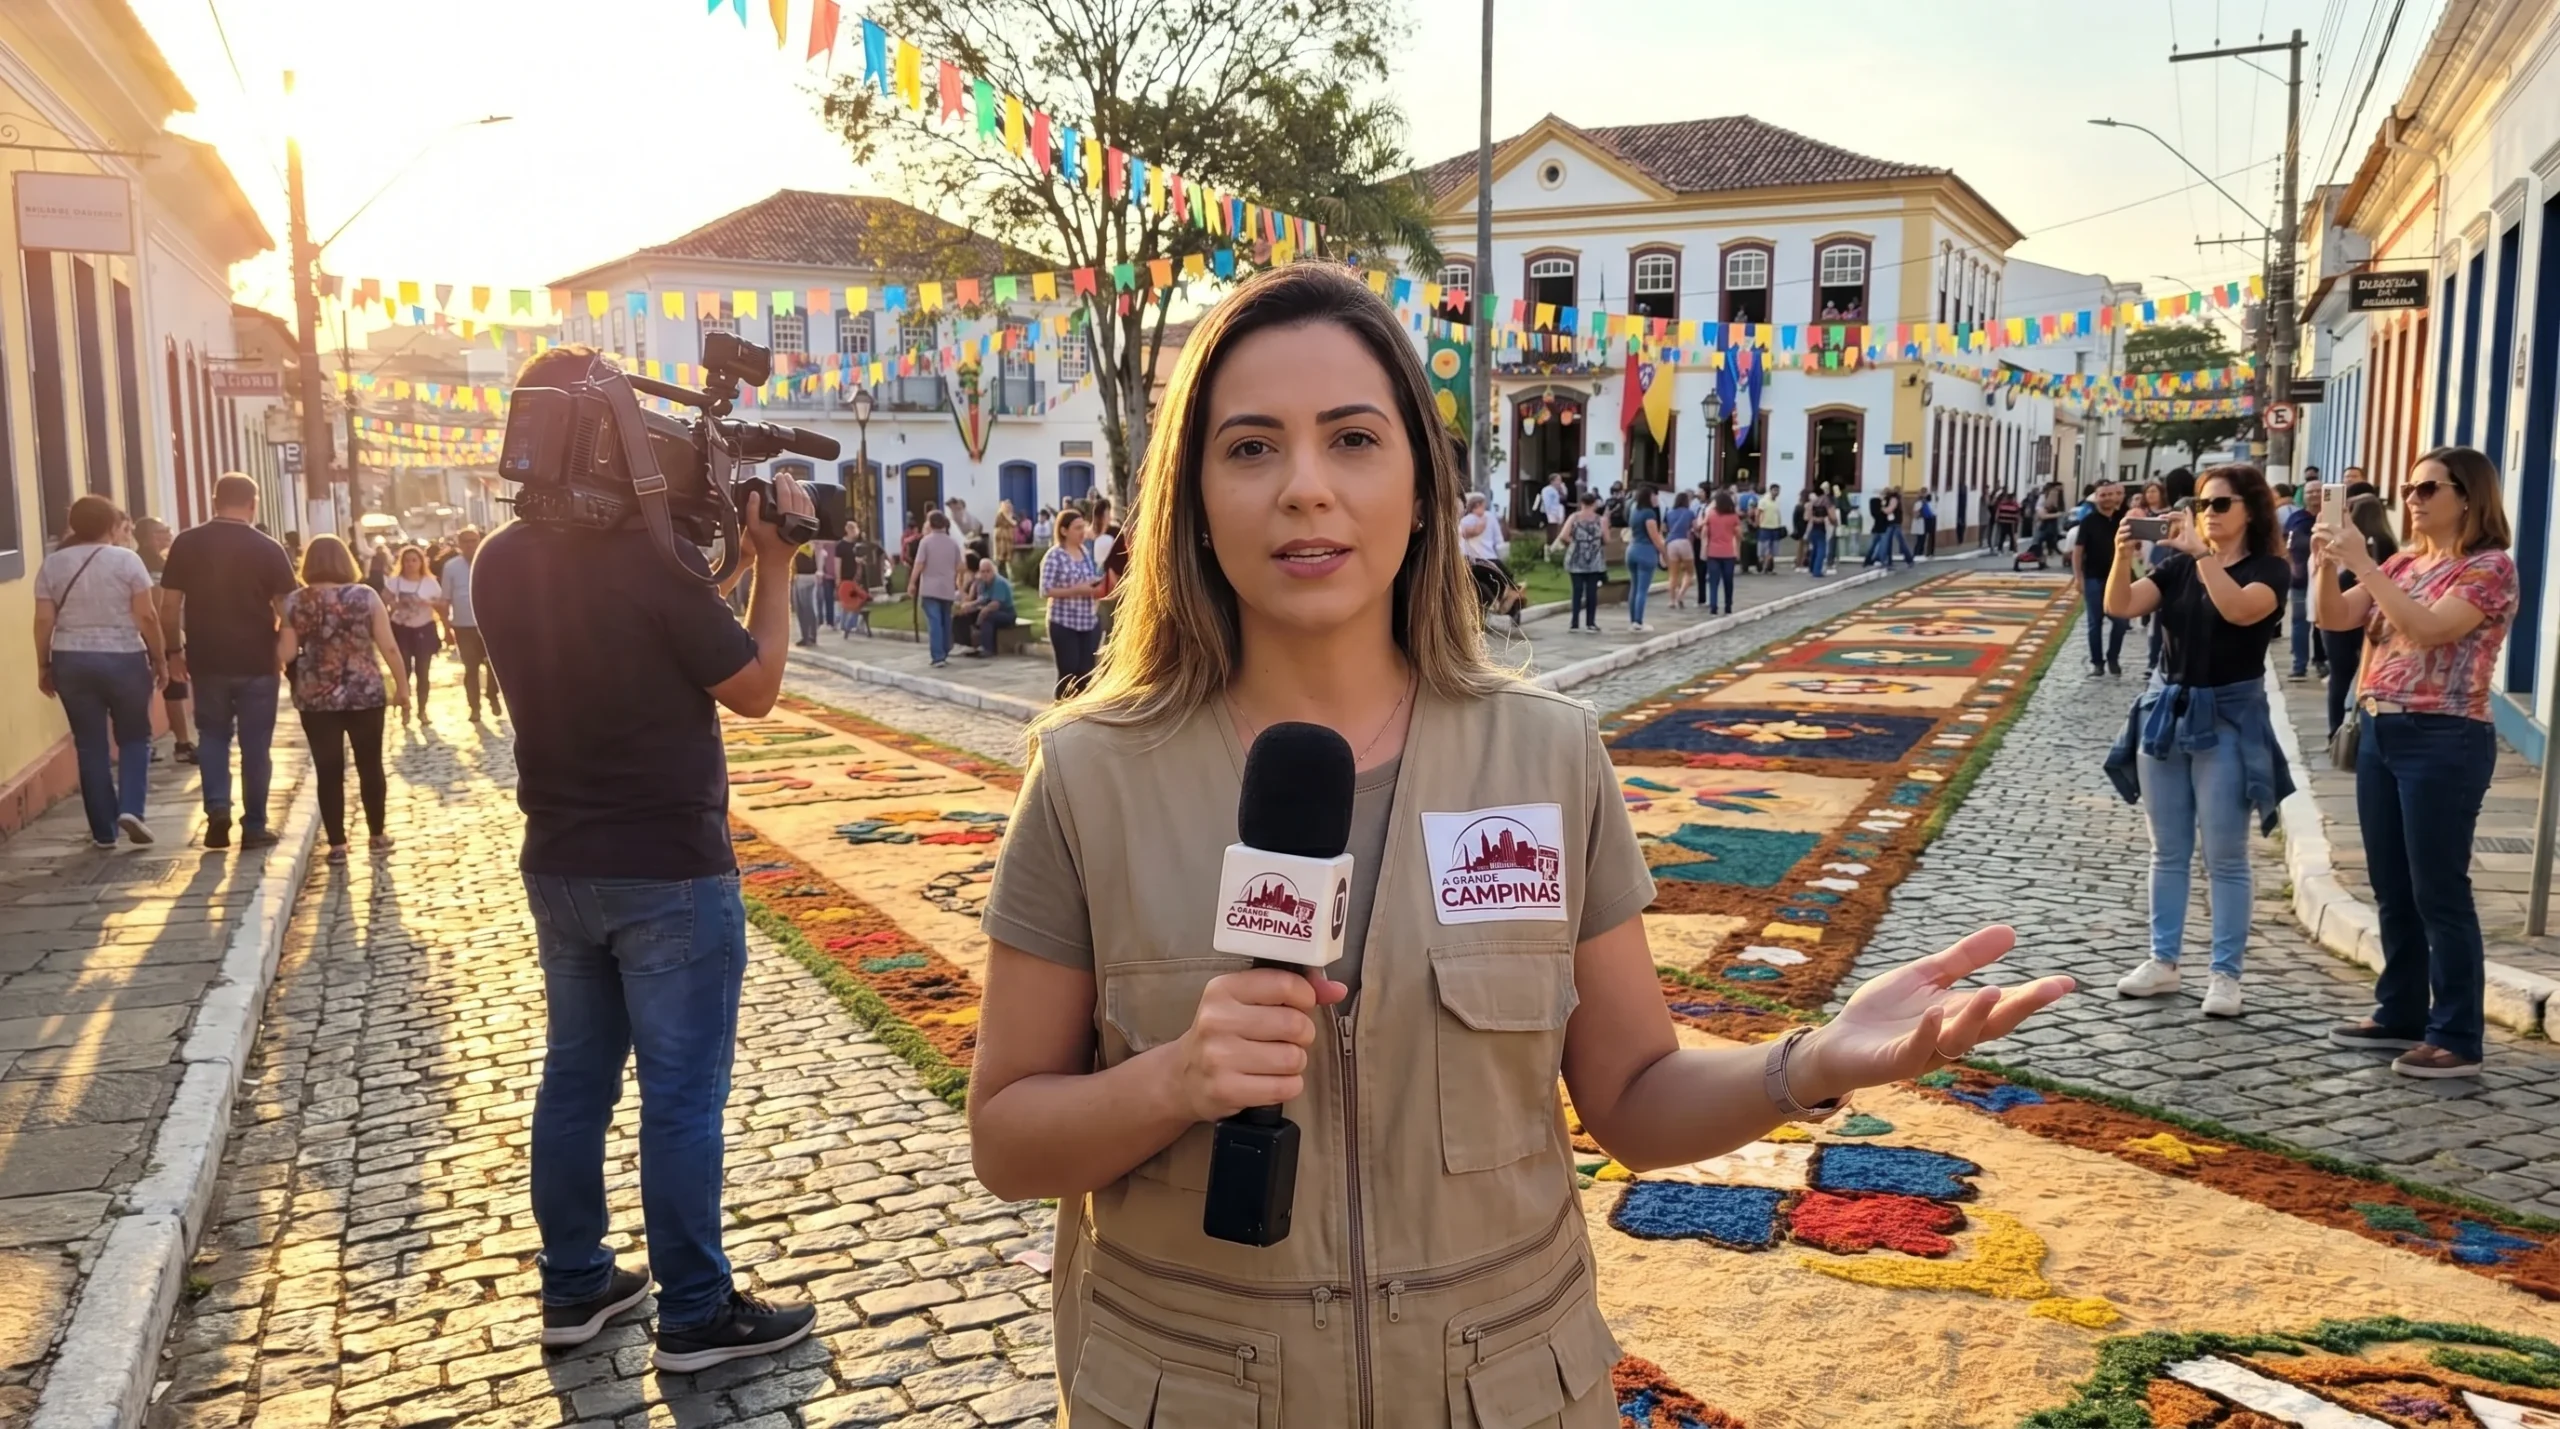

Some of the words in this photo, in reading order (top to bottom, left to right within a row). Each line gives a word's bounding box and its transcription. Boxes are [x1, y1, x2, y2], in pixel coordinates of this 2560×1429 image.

[2272, 408, 2288, 424] E
[1442, 878, 1450, 886] A
[1452, 873, 1499, 885] GRANDE
[1441, 882, 1561, 907] CAMPINAS
[1237, 907, 1269, 917] GRANDE
[1226, 913, 1313, 938] CAMPINAS
